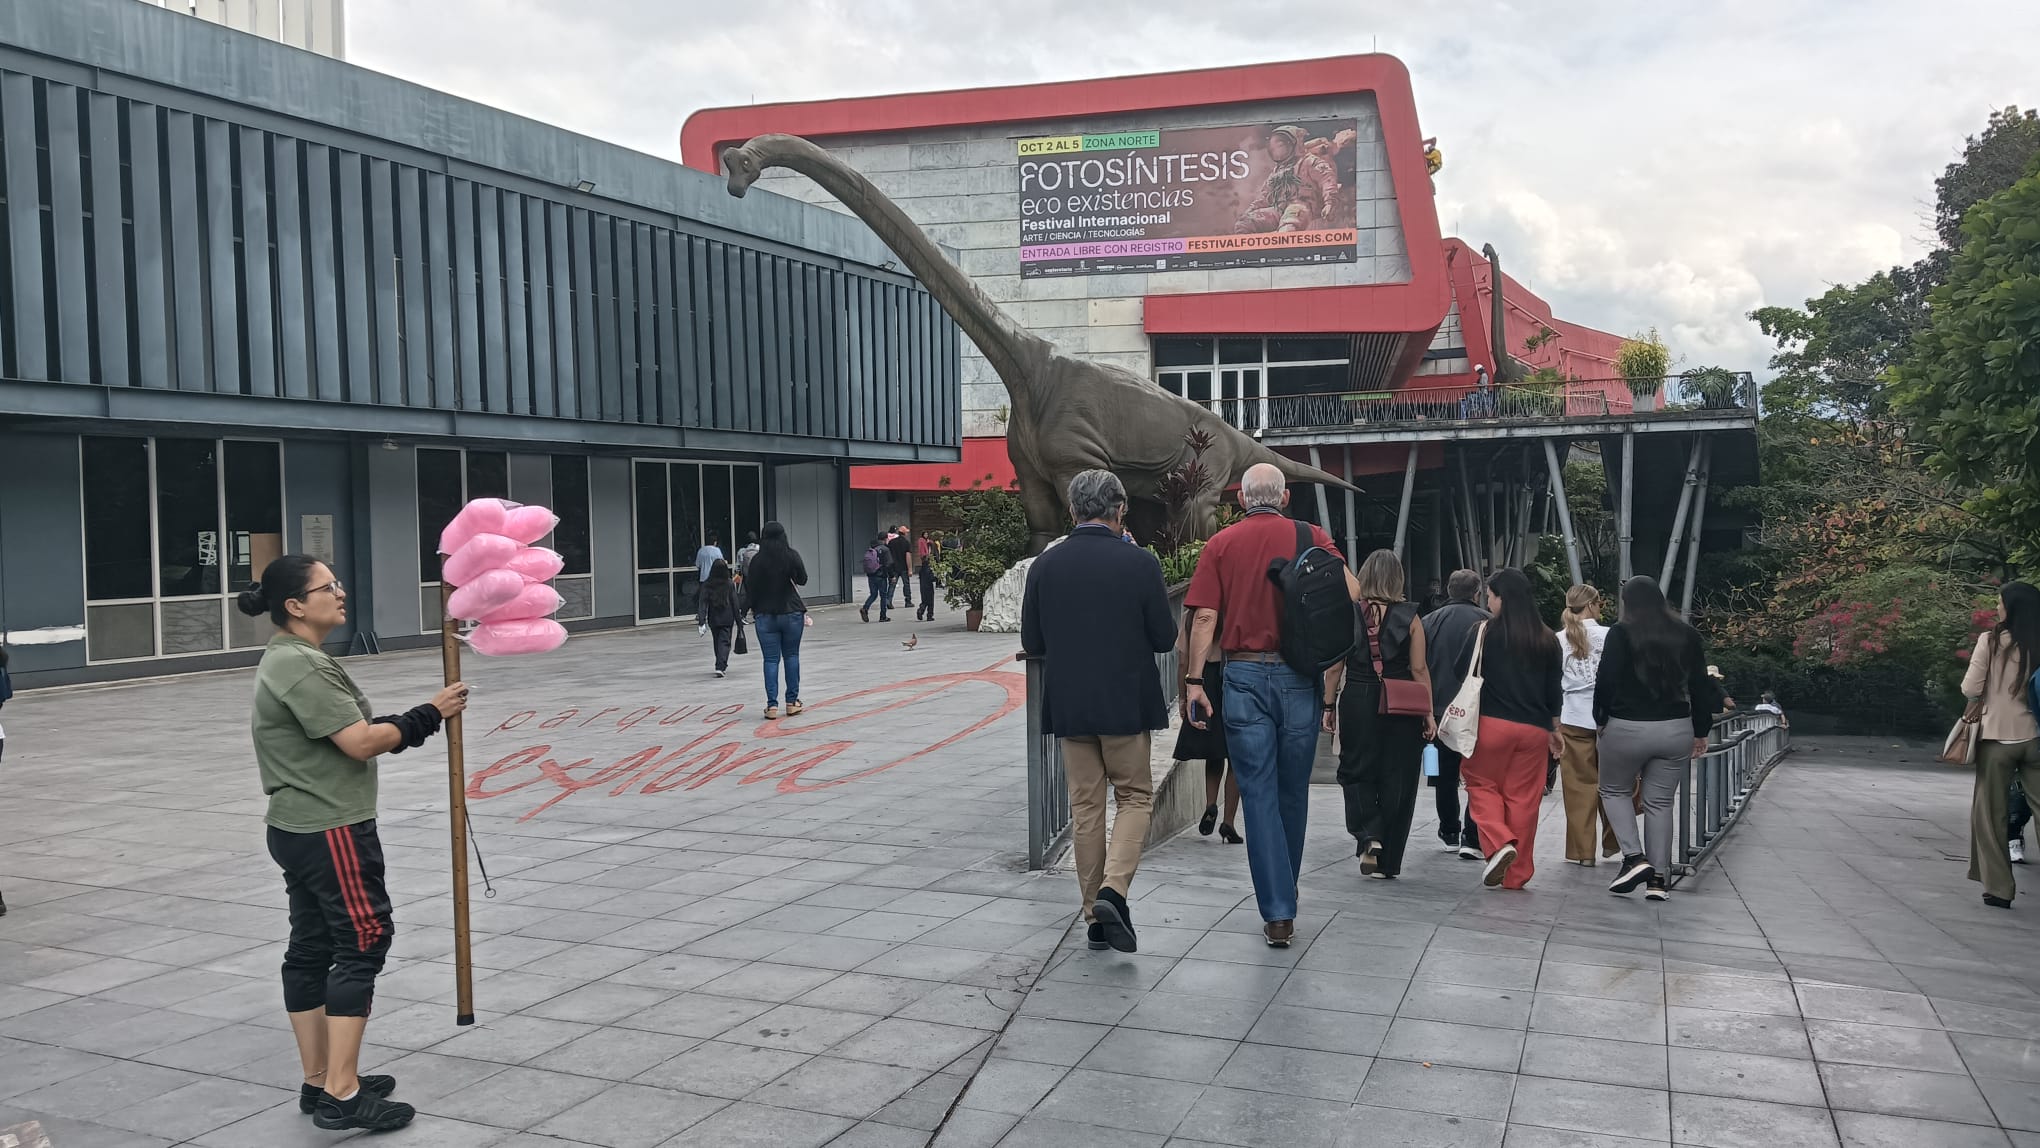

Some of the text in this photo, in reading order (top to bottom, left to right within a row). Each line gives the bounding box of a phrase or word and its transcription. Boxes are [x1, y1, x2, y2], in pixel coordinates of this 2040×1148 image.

[1020, 139, 1080, 153] OCT 2 AL 5
[1085, 134, 1156, 149] ZONA NORTE
[1020, 150, 1250, 192] FOTOSÍNTESIS
[1021, 186, 1194, 216] eco existencias
[1022, 211, 1171, 231] Festival Internacional
[1022, 233, 1043, 242] ARTE
[1049, 231, 1081, 241] CIENCIA
[1088, 227, 1145, 239] TECNOLOGÍAS
[1188, 232, 1353, 250] FESTIVALFOTOSINTESIS.COM
[1022, 241, 1183, 259] ENTRADA LIBRE CON REGISTRO
[484, 703, 744, 737] parque
[464, 719, 857, 823] explora
